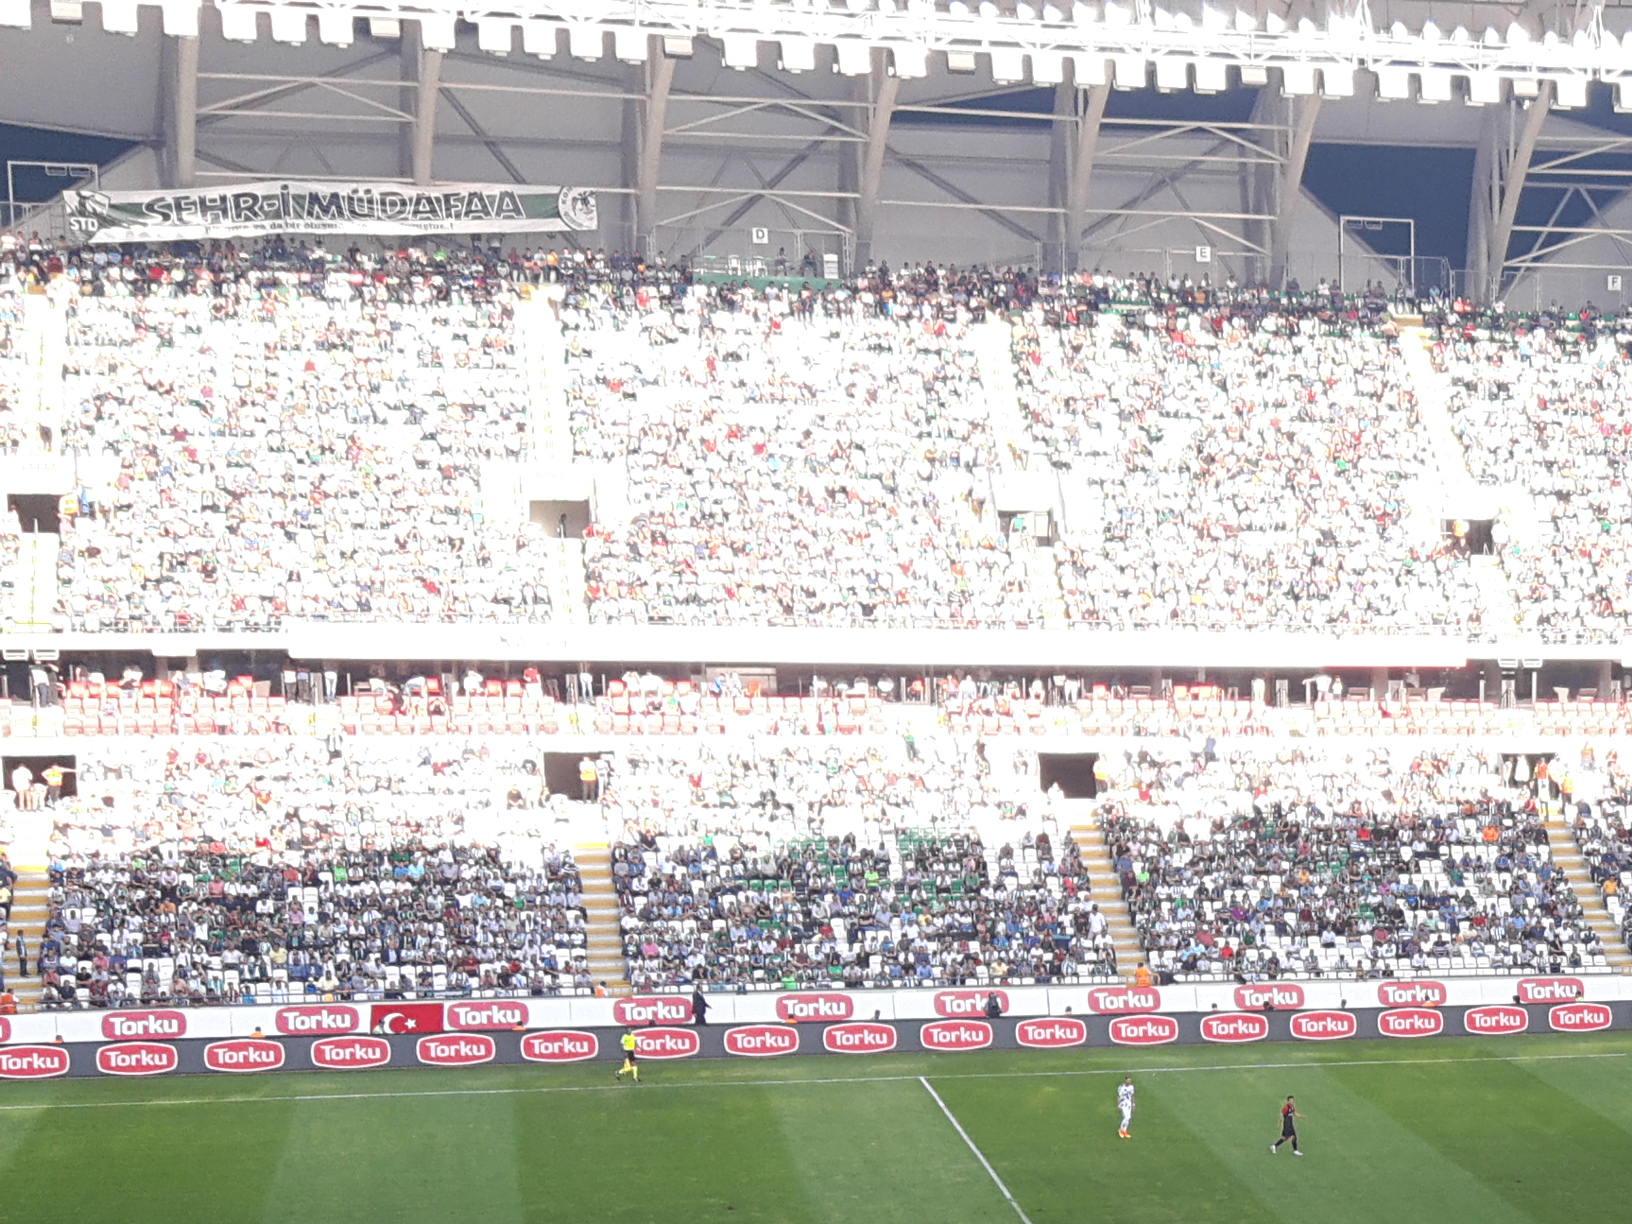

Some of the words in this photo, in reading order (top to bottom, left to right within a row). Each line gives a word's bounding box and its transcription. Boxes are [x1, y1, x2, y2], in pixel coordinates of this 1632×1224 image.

[303, 187, 527, 222] MÜDAFAA
[755, 229, 766, 241] D
[1200, 248, 1208, 260] E
[1611, 277, 1619, 289] F
[1239, 988, 1300, 1007] Torku
[1383, 984, 1441, 1004] Torku
[1522, 981, 1579, 1000] Torku
[619, 1000, 686, 1020] Torku
[782, 996, 847, 1017] Torku
[1098, 990, 1156, 1011] Torku
[111, 1012, 179, 1034] Torku
[282, 1008, 352, 1031] Torku
[453, 1004, 522, 1026] Torku
[1385, 1014, 1437, 1032] Torku
[1472, 1011, 1522, 1029] Torku
[1556, 1009, 1606, 1026] Torku
[1023, 1023, 1079, 1042] Torku
[1117, 1021, 1171, 1039] Torku
[1208, 1018, 1261, 1037] Torku
[1297, 1016, 1350, 1034] Torku
[636, 1033, 692, 1053] Torku
[732, 1031, 791, 1050] Torku
[831, 1028, 889, 1048] Torku
[928, 1026, 985, 1045] Torku
[212, 1046, 276, 1066] Torku
[319, 1043, 382, 1062] Torku
[425, 1040, 487, 1059] Torku
[529, 1037, 590, 1056] Torku
[0, 1052, 60, 1072] Torku
[105, 1049, 169, 1069] Torku
